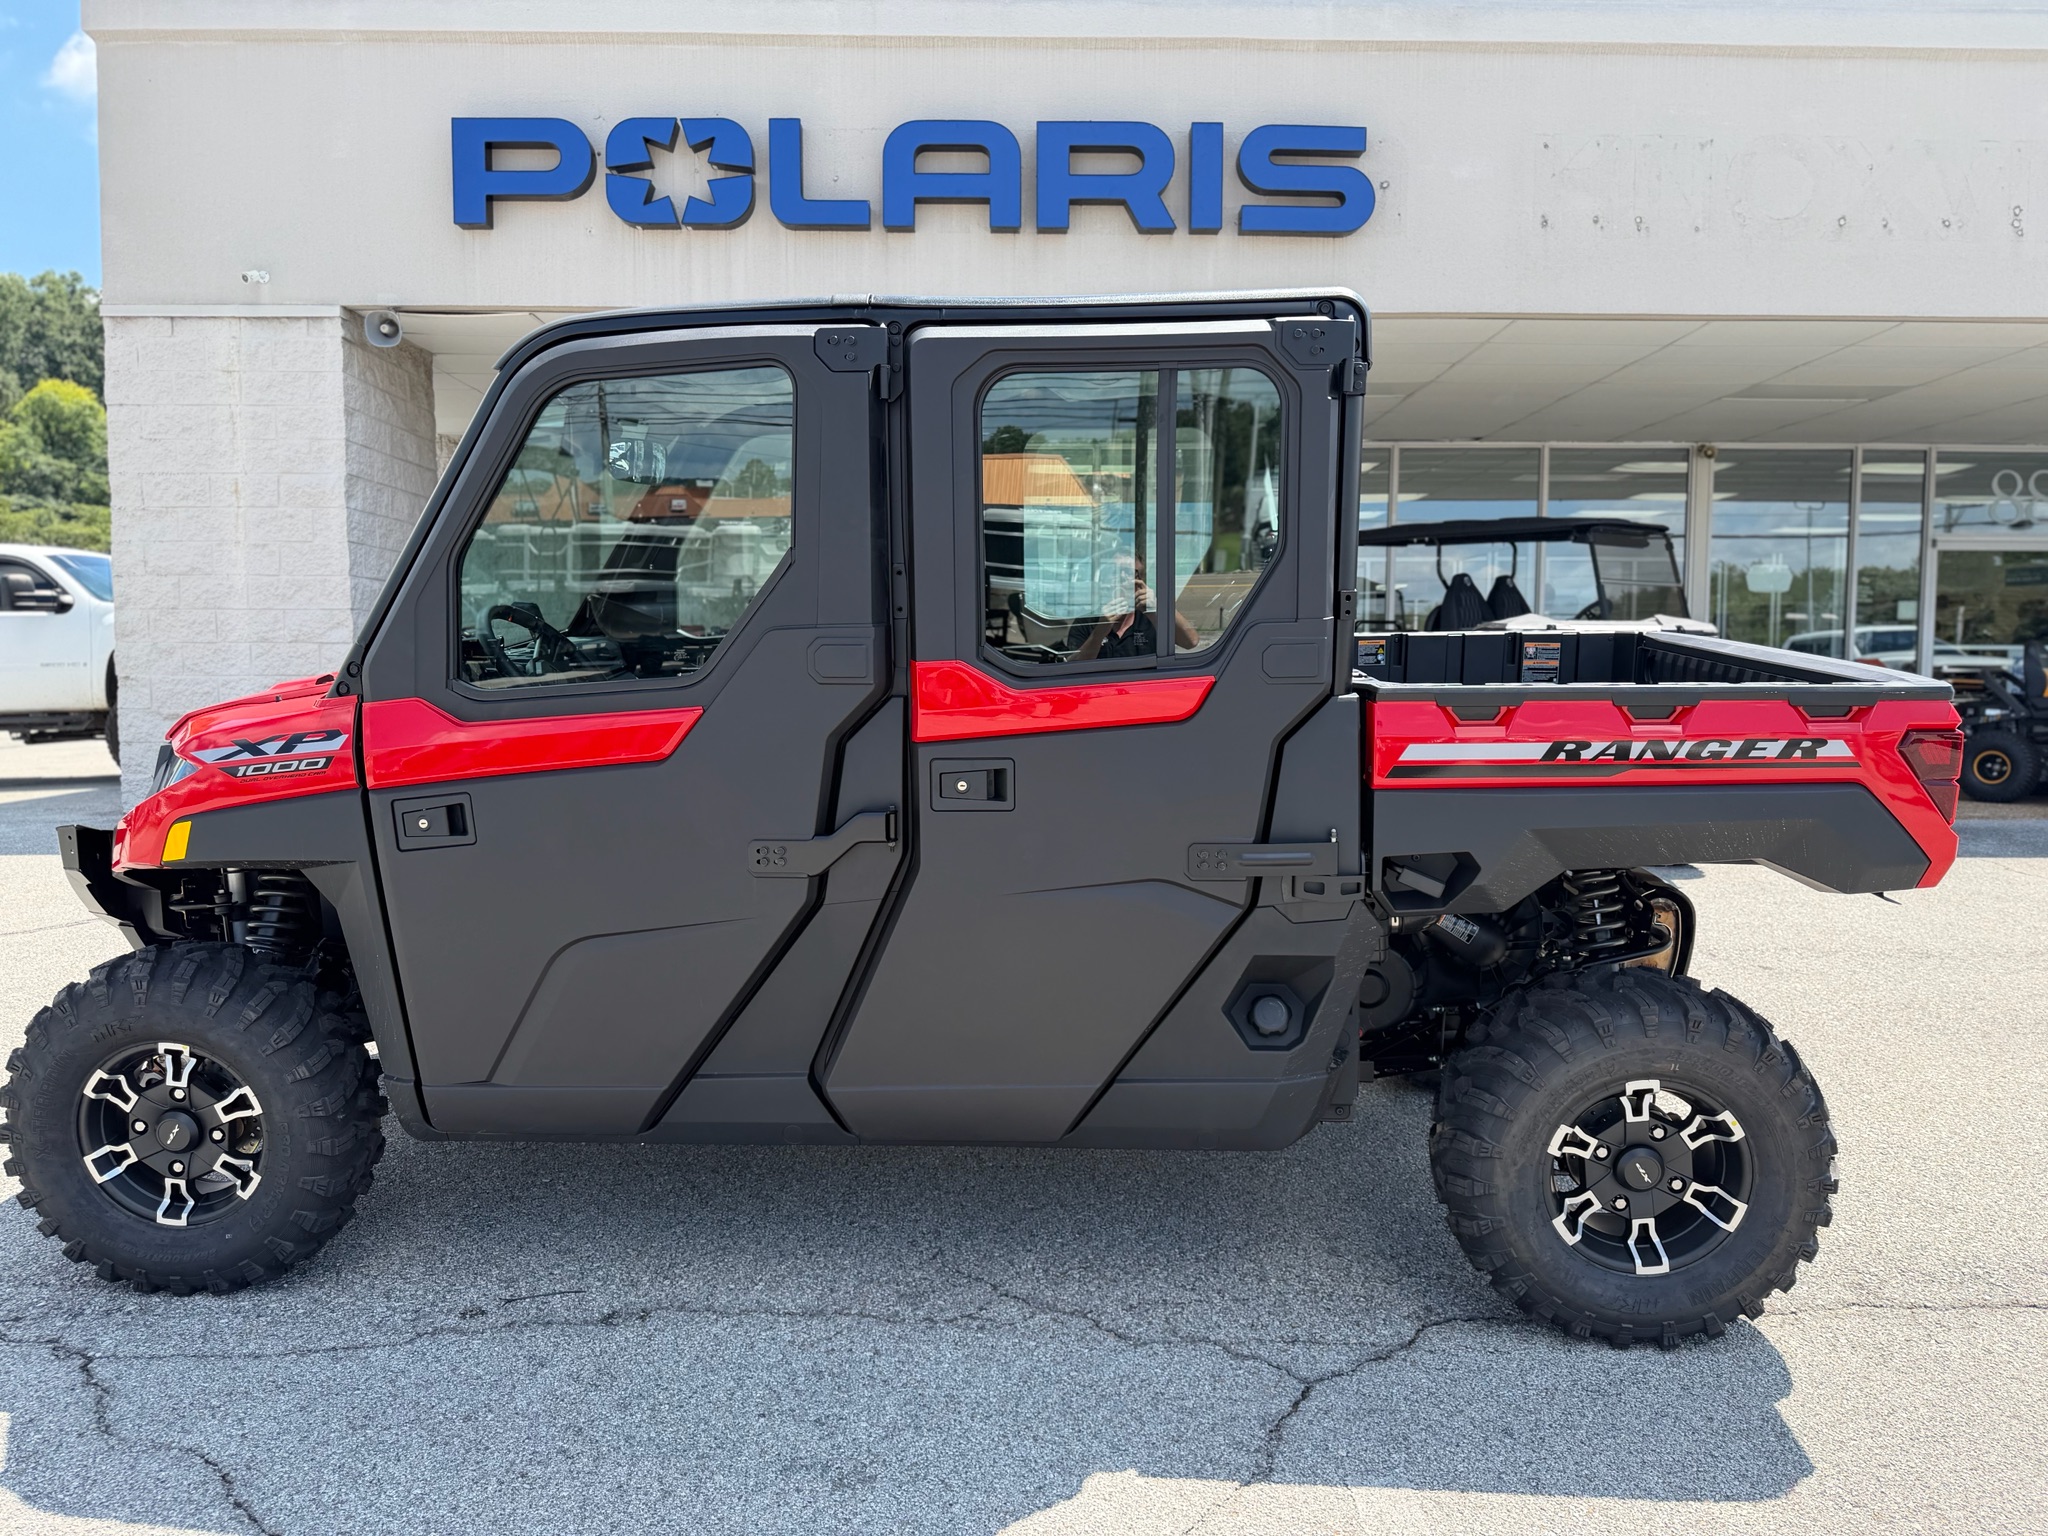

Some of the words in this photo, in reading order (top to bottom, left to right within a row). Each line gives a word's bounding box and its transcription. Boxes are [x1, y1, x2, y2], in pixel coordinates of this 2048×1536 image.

[451, 116, 1377, 237] POLARIS
[211, 728, 345, 763] XP
[1538, 737, 1829, 762] RANGER
[236, 757, 327, 777] 1000
[262, 772, 308, 782] OVERHEAD
